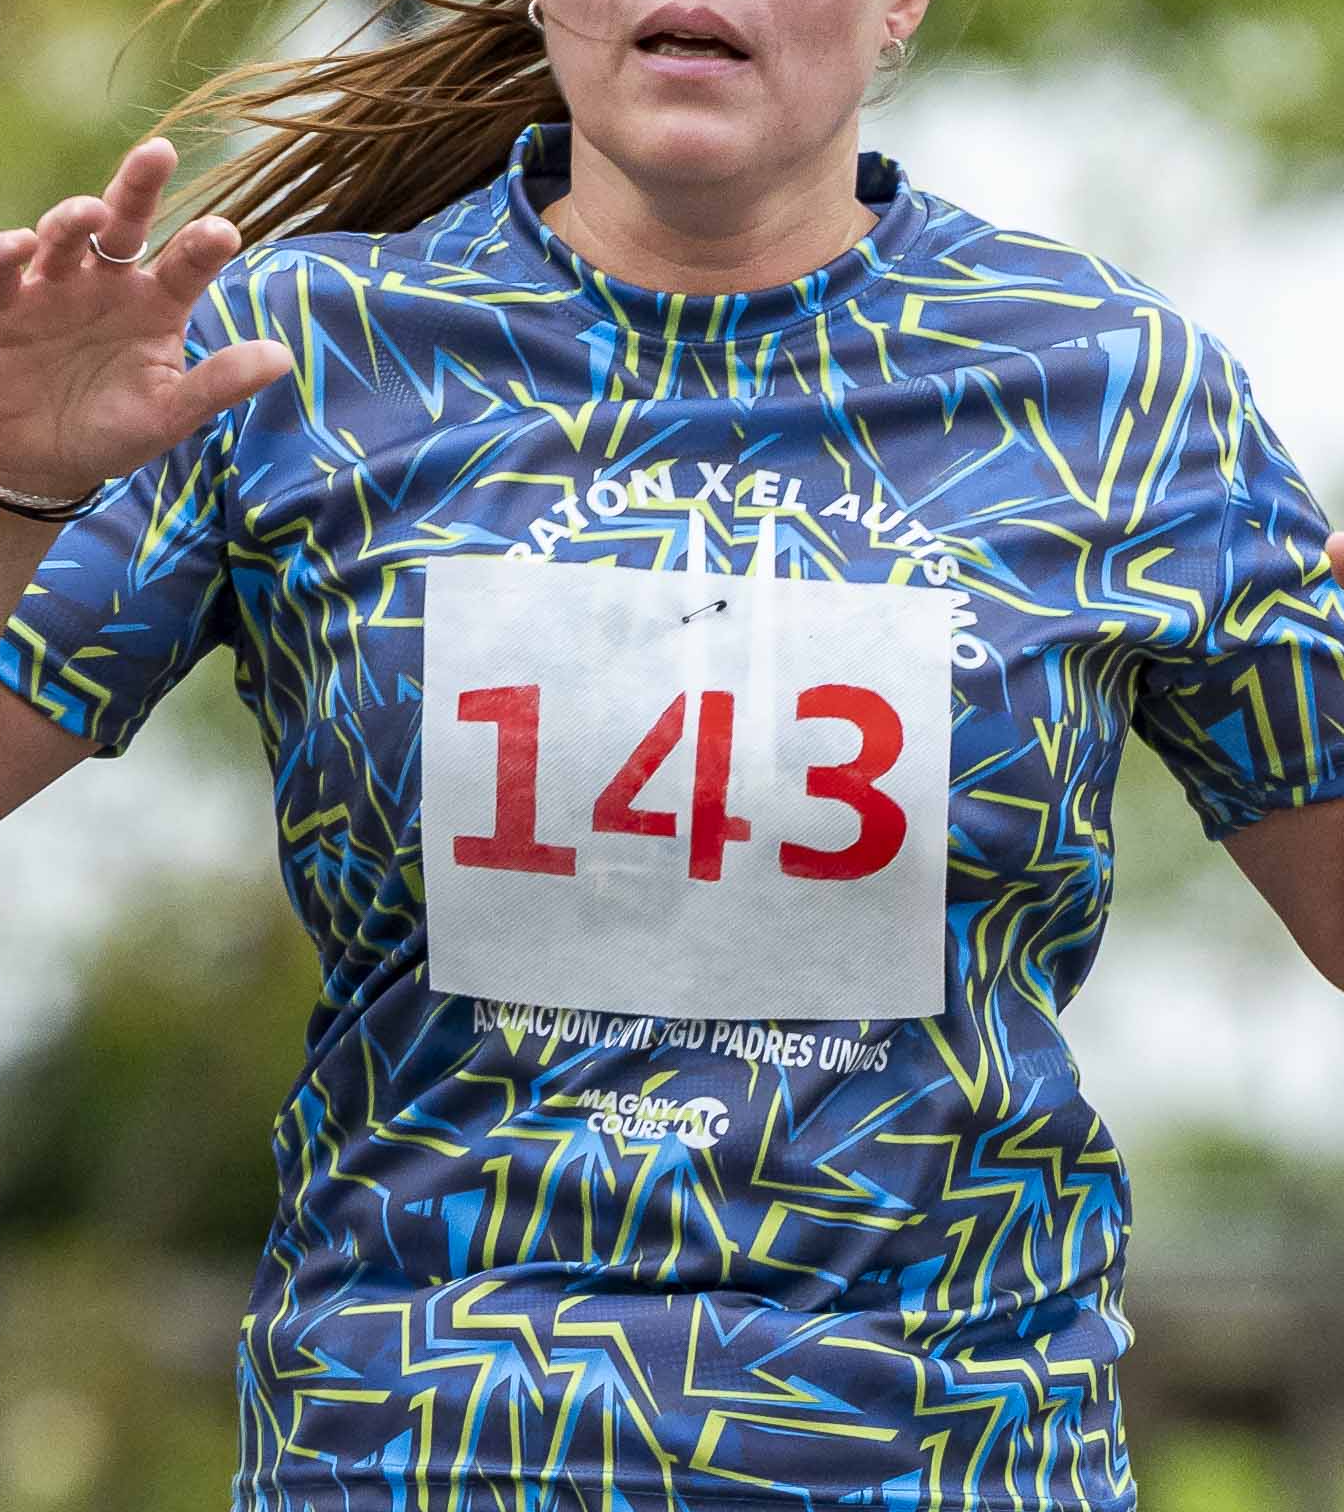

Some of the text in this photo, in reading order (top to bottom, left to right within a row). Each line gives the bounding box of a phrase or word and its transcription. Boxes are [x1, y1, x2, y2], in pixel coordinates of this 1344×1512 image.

[694, 462, 733, 503] X
[752, 469, 807, 512] EL
[819, 492, 988, 670] AUTISMO
[453, 684, 907, 881] 143
[711, 1020, 816, 1068] PADRES
[576, 1088, 678, 1120] MAGNY
[587, 1111, 670, 1139] COURS
